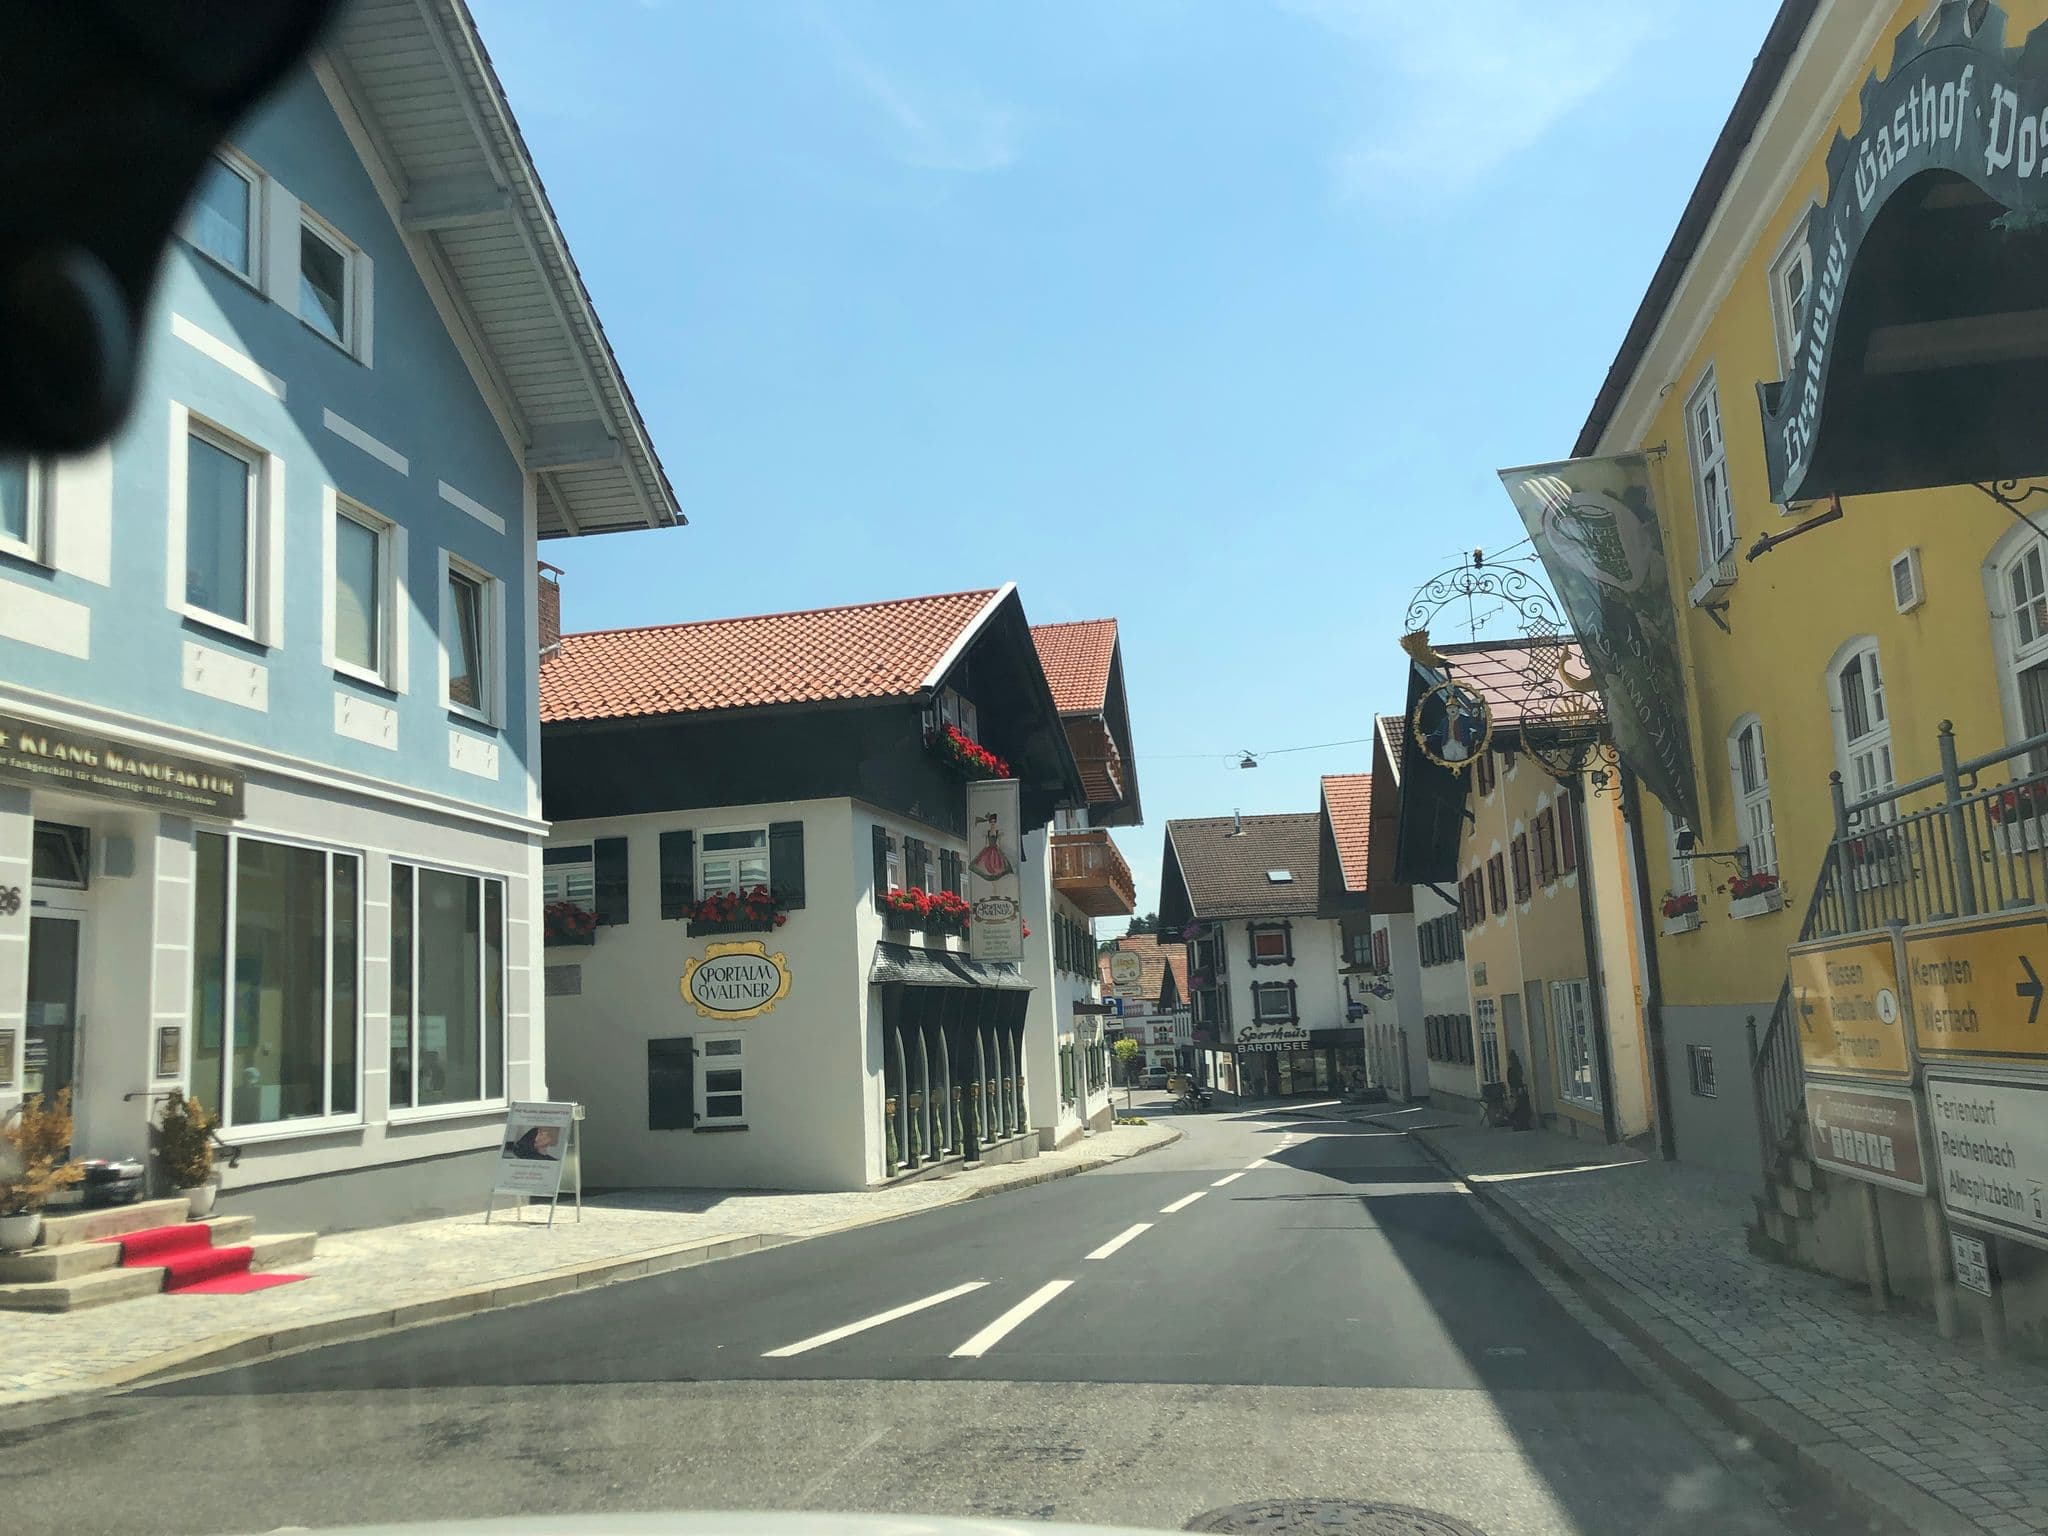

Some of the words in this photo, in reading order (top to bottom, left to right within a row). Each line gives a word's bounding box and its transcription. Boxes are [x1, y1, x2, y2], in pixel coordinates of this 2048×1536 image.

[1854, 63, 1974, 213] Gasthof
[20, 731, 97, 768] KLANG
[104, 749, 234, 796] MANUFAKTUR
[700, 965, 773, 984] SPORTALM
[1911, 953, 1972, 986] Kempten
[698, 983, 771, 1000] WALTNER
[1237, 1026, 1308, 1042] Sporthaus
[1237, 1041, 1309, 1053] BARONSEE
[1936, 1092, 1997, 1126] Feriendorf
[1941, 1130, 2016, 1169] Reichenbach
[1949, 1168, 2025, 1213] Alpspitzbahn
